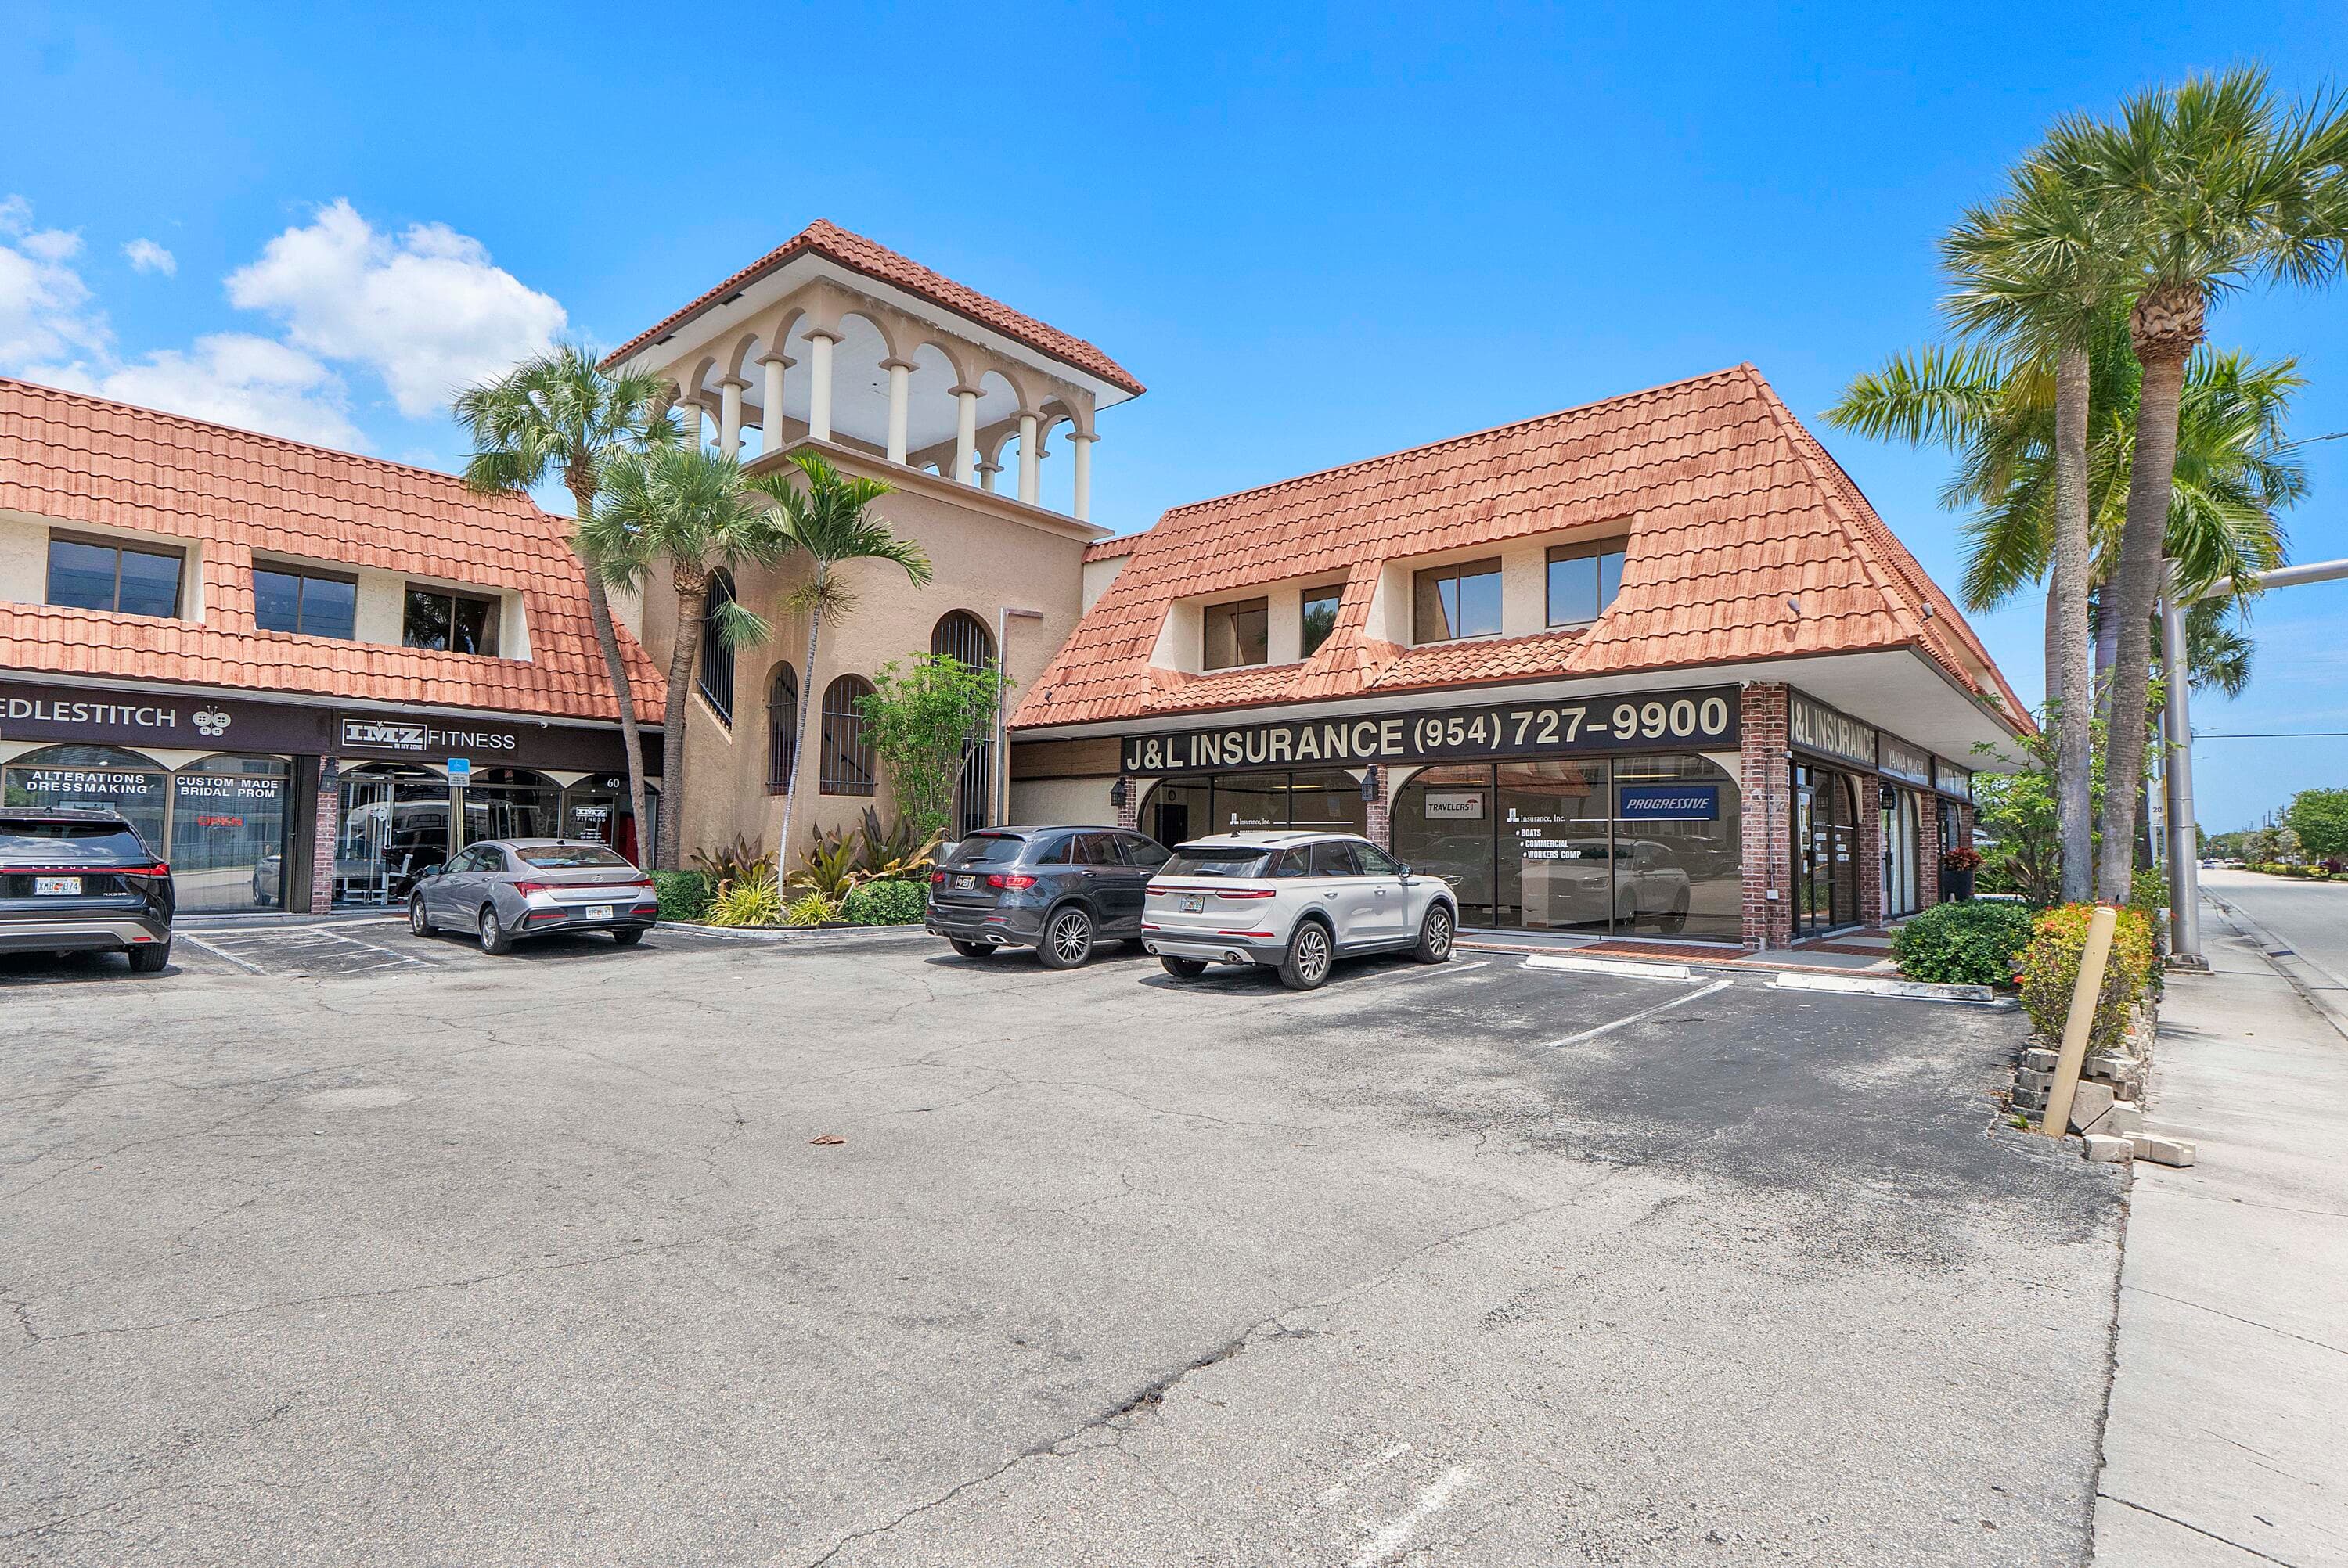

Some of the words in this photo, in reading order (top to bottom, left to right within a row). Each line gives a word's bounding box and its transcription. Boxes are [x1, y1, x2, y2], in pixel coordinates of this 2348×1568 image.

[346, 725, 423, 743] IMZ
[428, 730, 516, 750] FITNESS
[1127, 737, 1183, 771] J&L
[1190, 719, 1404, 765] INSURANCE
[1414, 713, 1502, 753] (954)
[1511, 697, 1728, 745] 727-9900
[1815, 709, 1876, 764] INSURANCE
[32, 771, 145, 784] ALTERATIONS
[176, 776, 234, 787] CUSTOM
[241, 779, 278, 789] MADE
[607, 778, 620, 788] 60
[27, 782, 147, 794] DRESSMAKING
[180, 786, 229, 797] BRIDAL
[238, 788, 275, 798] PROM
[1626, 798, 1709, 809] PROGRESSIVE
[1521, 815, 1552, 823] Insurance,
